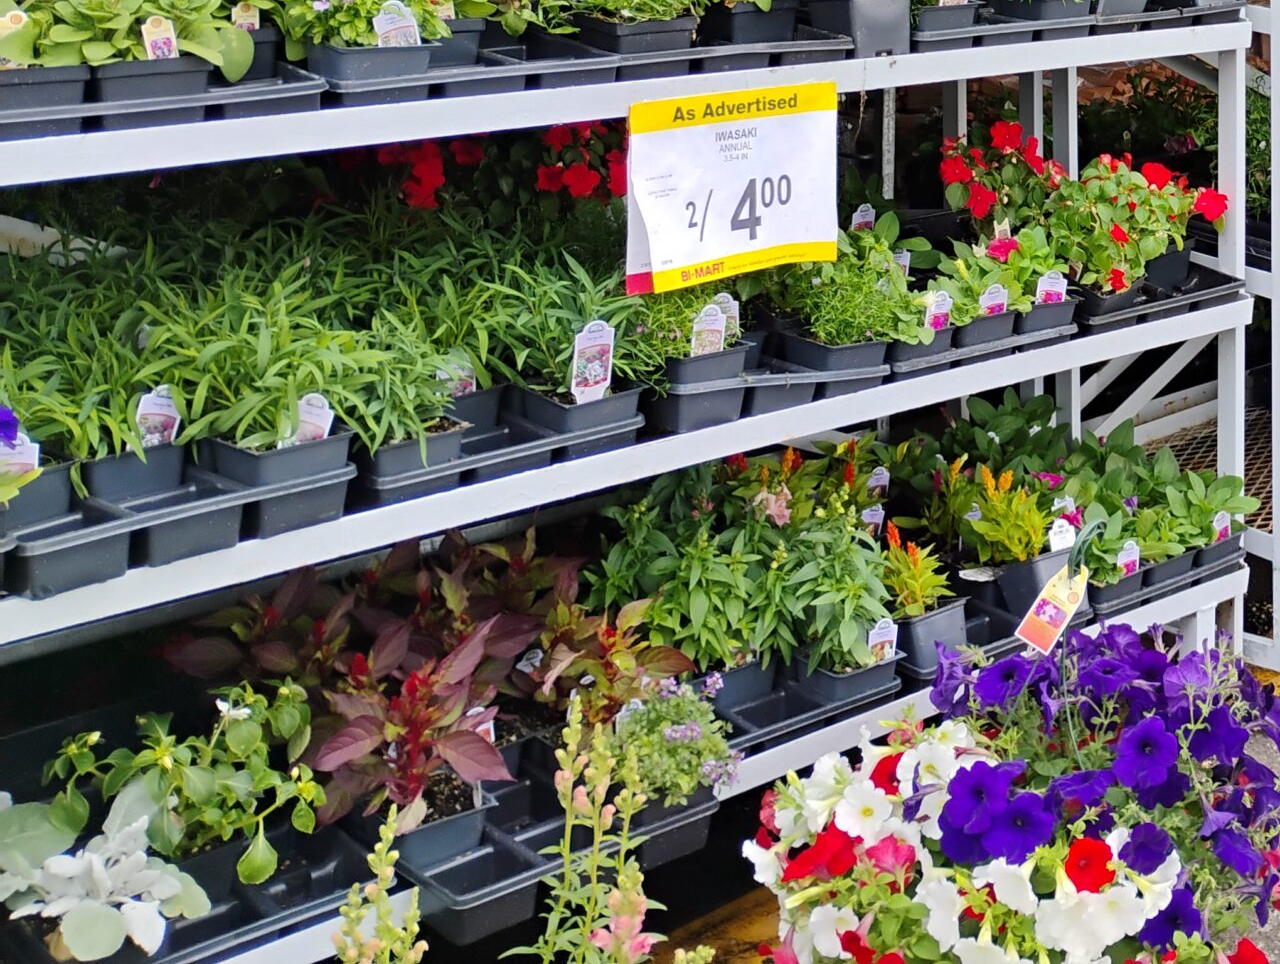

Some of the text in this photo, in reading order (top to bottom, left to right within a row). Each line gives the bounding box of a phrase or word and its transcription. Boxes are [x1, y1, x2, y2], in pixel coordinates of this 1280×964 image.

[672, 93, 798, 124] As Advertised
[715, 127, 758, 143] IWASAKI
[718, 140, 753, 154] ANNUAL
